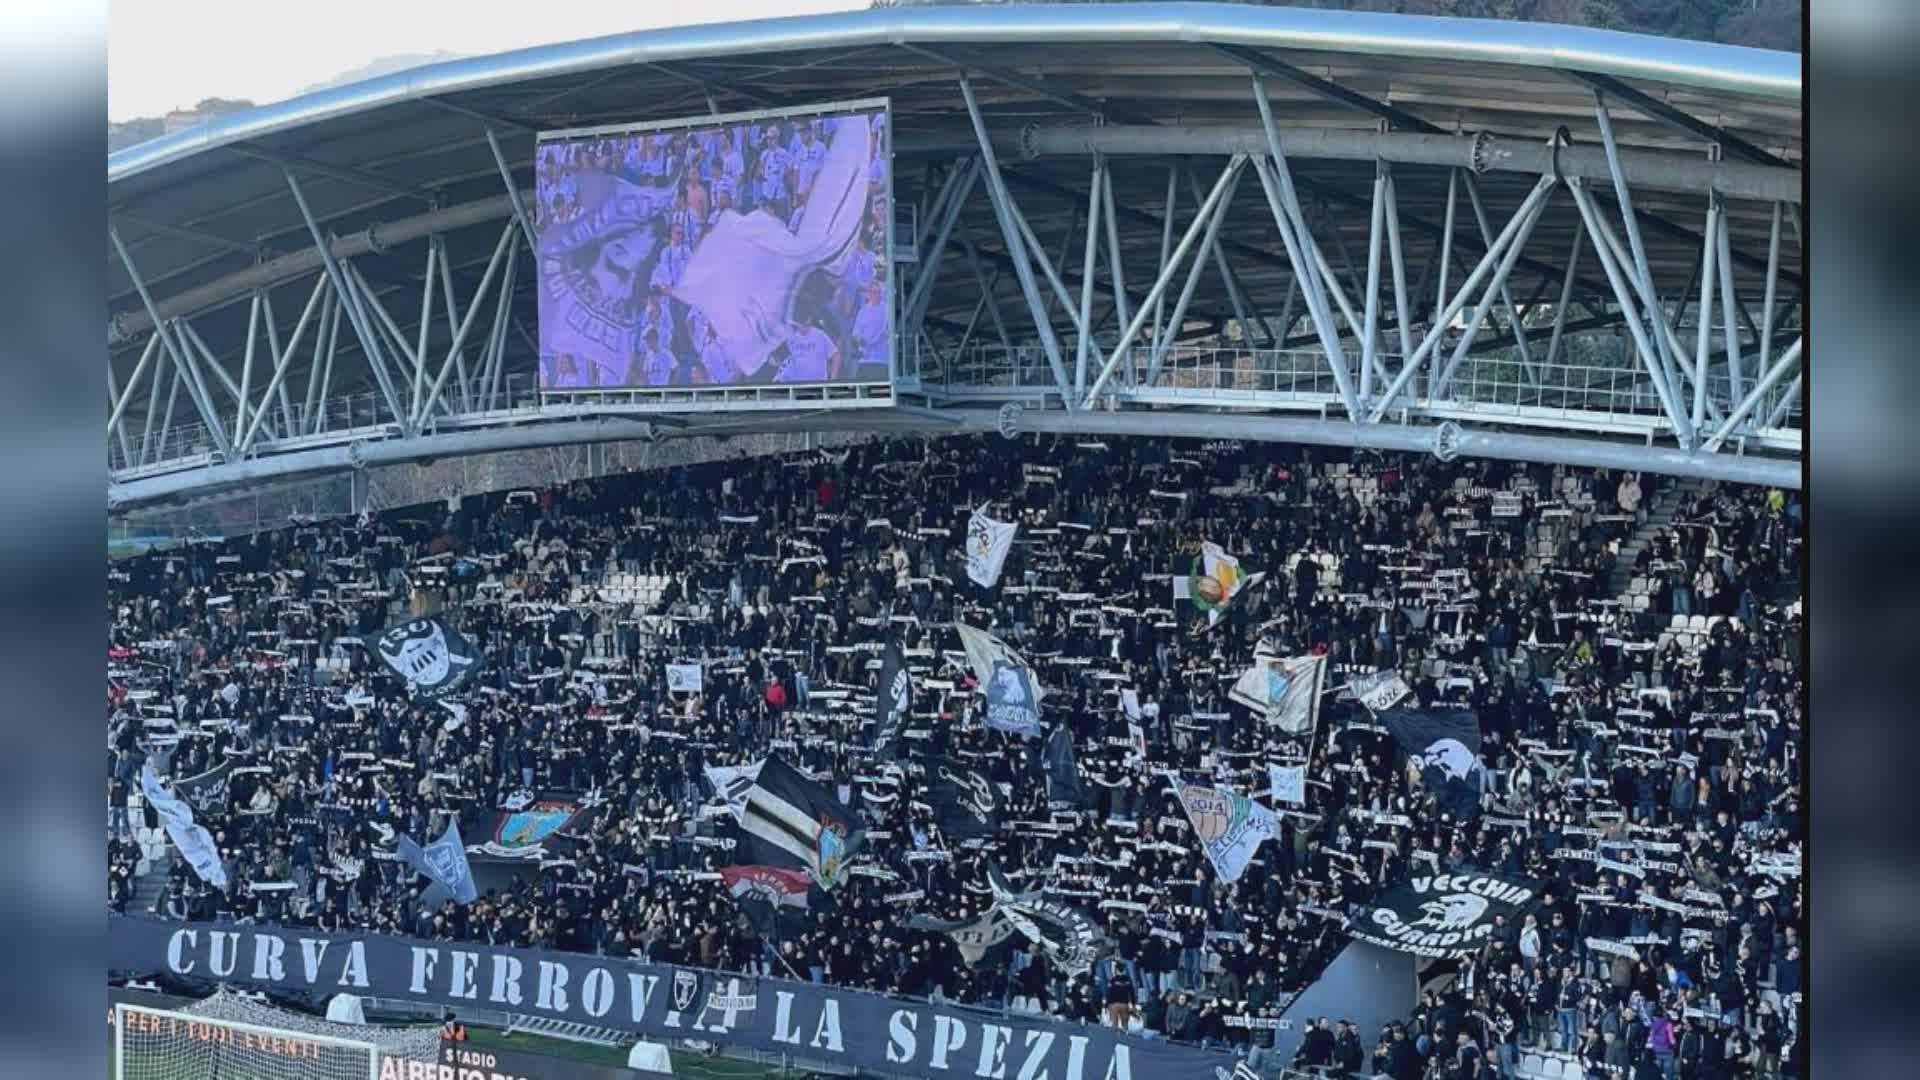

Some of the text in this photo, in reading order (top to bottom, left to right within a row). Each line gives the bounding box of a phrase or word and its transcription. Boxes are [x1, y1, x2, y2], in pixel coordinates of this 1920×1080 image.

[1411, 874, 1533, 906] VECCHIA
[1372, 907, 1494, 947] GUARDIA
[167, 928, 370, 987] CURVA
[772, 991, 844, 1051] LA
[887, 1010, 1133, 1080] SPEZIA
[445, 1048, 497, 1068] STADIO
